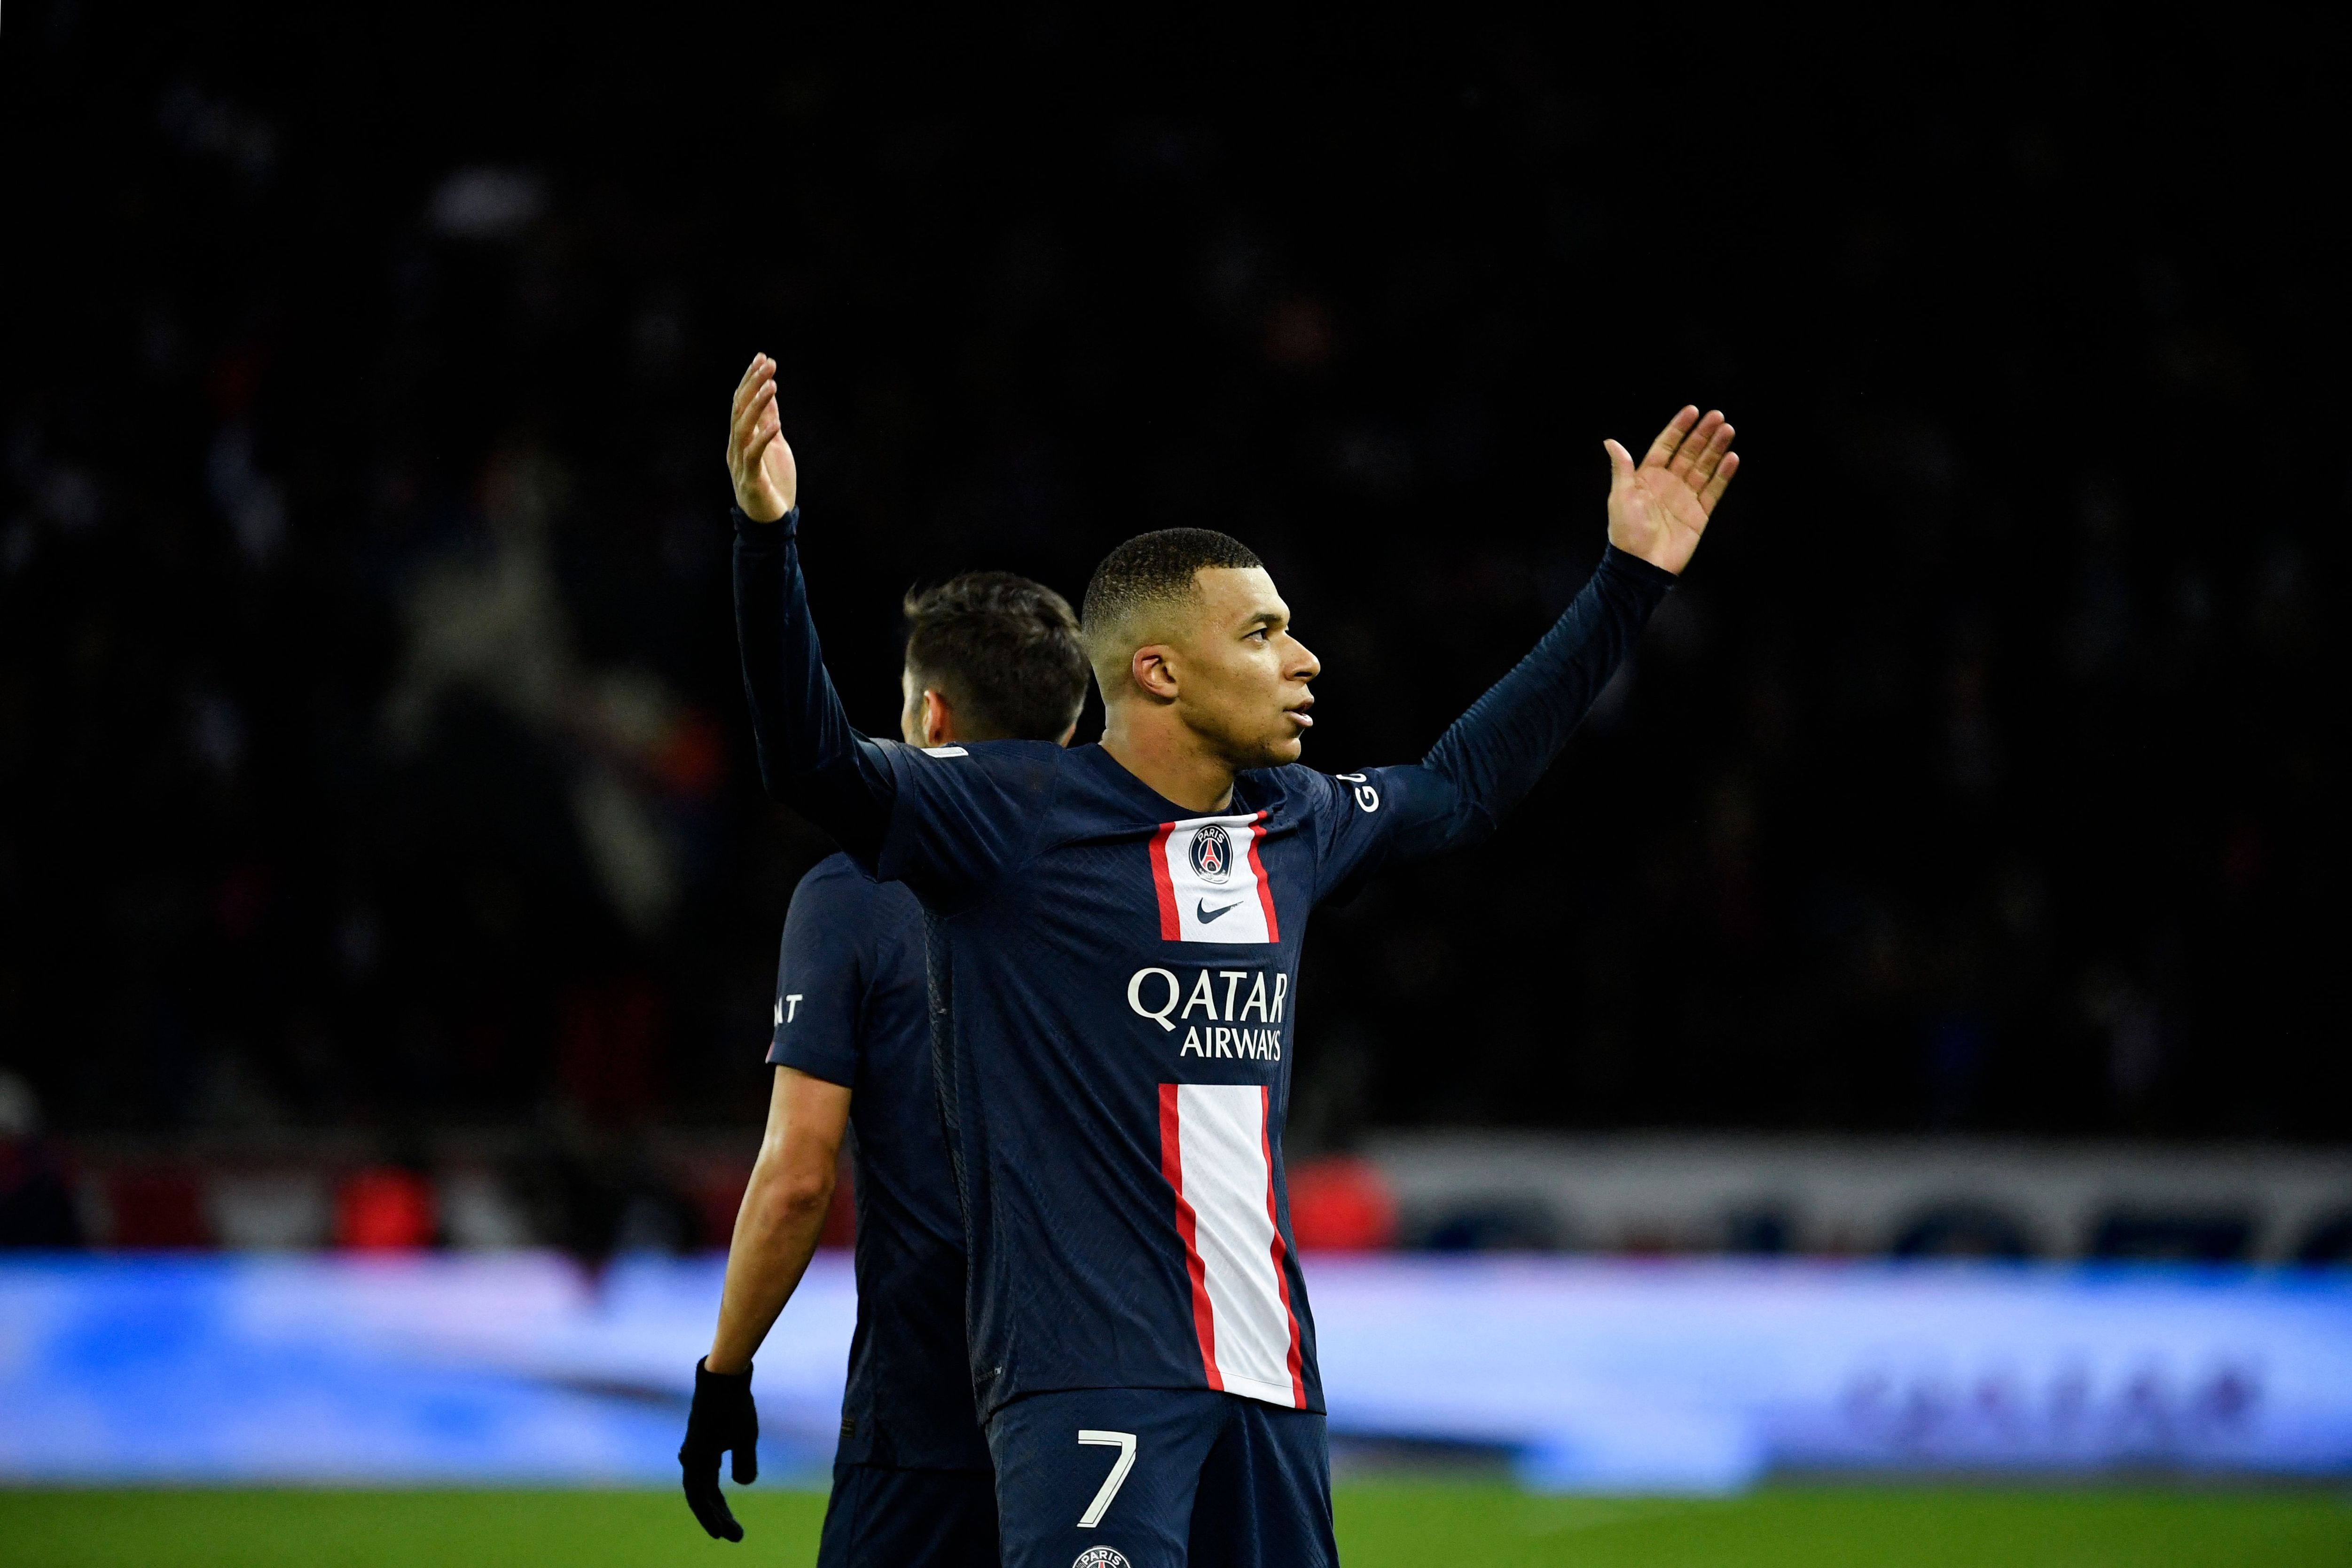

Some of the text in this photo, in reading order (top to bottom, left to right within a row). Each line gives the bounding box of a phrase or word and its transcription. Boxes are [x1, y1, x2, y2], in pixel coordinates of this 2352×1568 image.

[1198, 829, 1225, 843] PARIS
[1128, 967, 1287, 1032] QATAR
[1180, 1026, 1281, 1061] AIRWAYS
[1076, 1430, 1137, 1528] 7
[1081, 1550, 1122, 1566] PARIS
